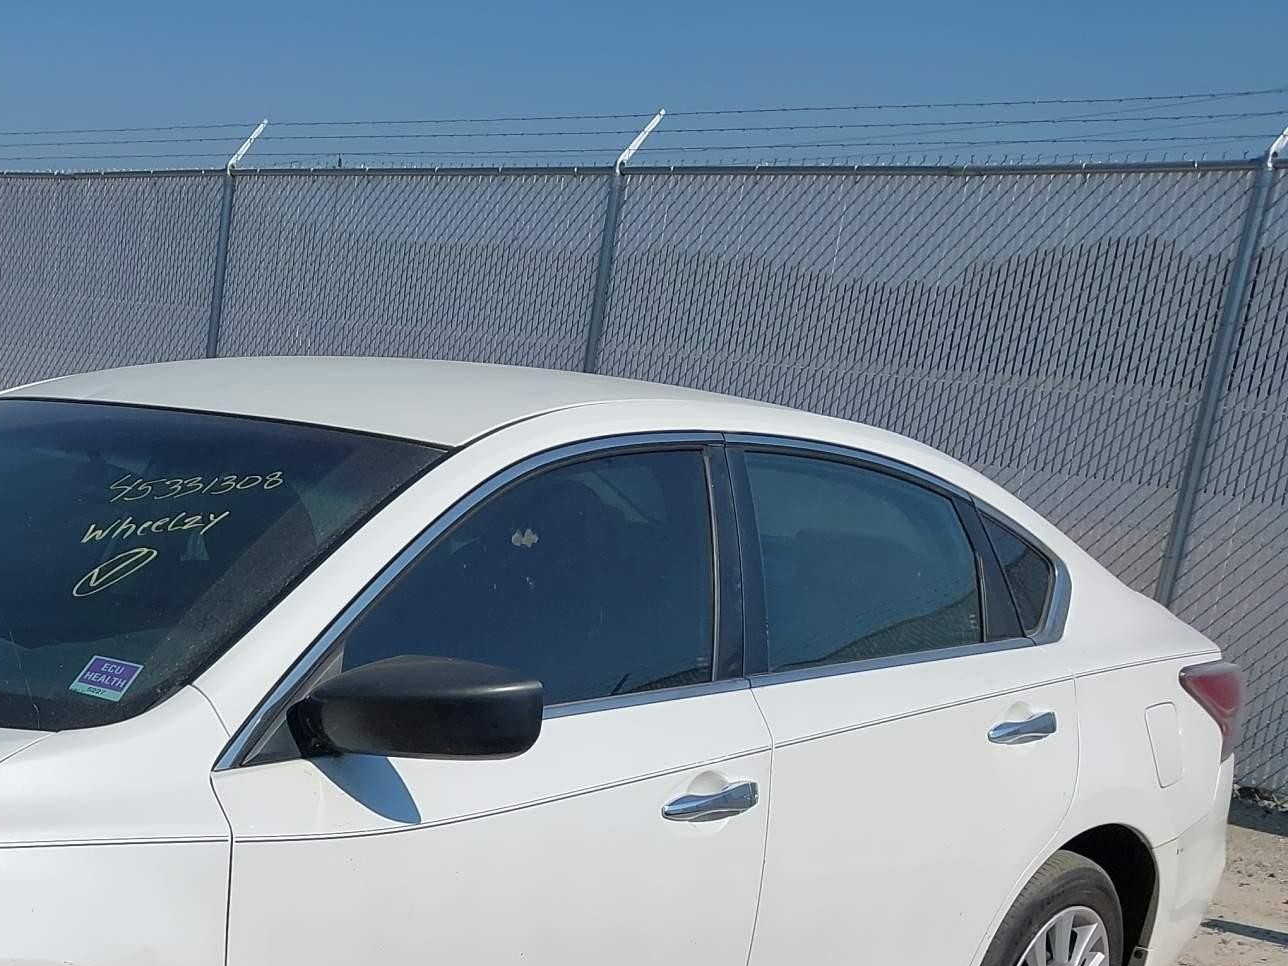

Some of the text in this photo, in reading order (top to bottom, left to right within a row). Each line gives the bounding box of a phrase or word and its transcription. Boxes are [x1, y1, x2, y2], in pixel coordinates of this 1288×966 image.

[109, 471, 284, 503] 45331308
[101, 663, 125, 675] ECU
[83, 671, 127, 688] HEALTH
